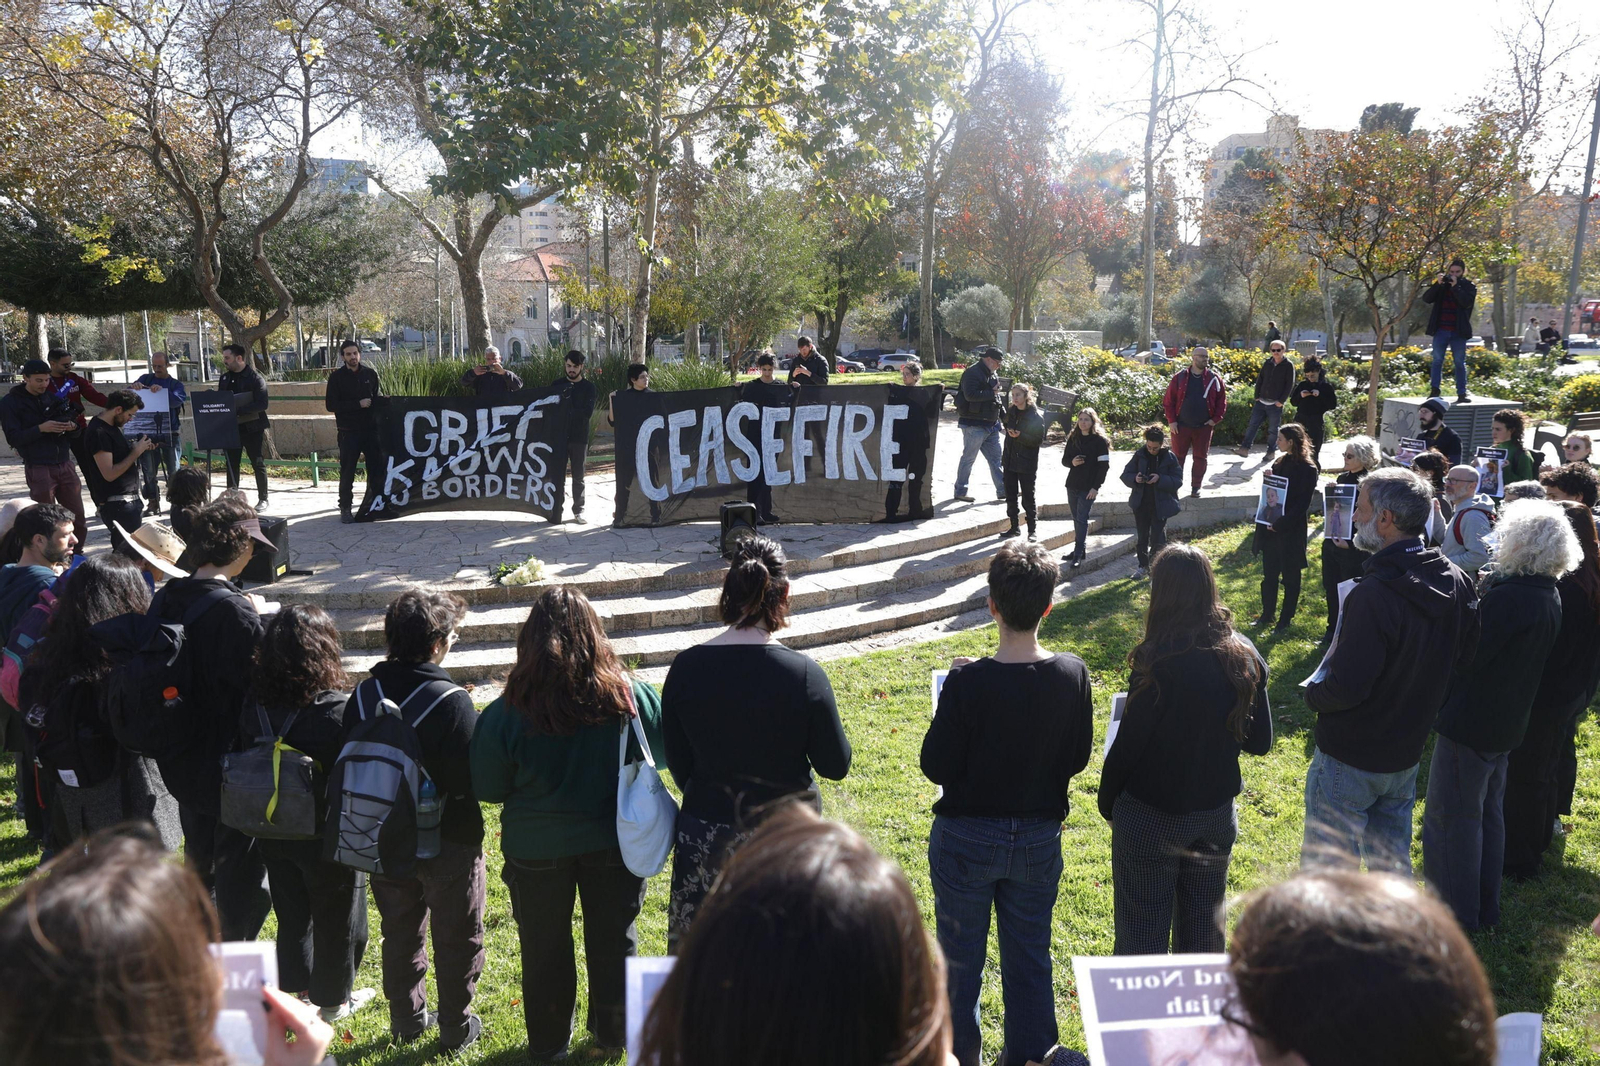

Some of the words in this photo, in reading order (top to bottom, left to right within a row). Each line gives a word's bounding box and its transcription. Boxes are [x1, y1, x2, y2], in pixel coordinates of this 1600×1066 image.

[403, 394, 561, 458] GRIEF
[635, 401, 916, 502] CEASEFIRE.
[421, 473, 557, 511] BORDERS
